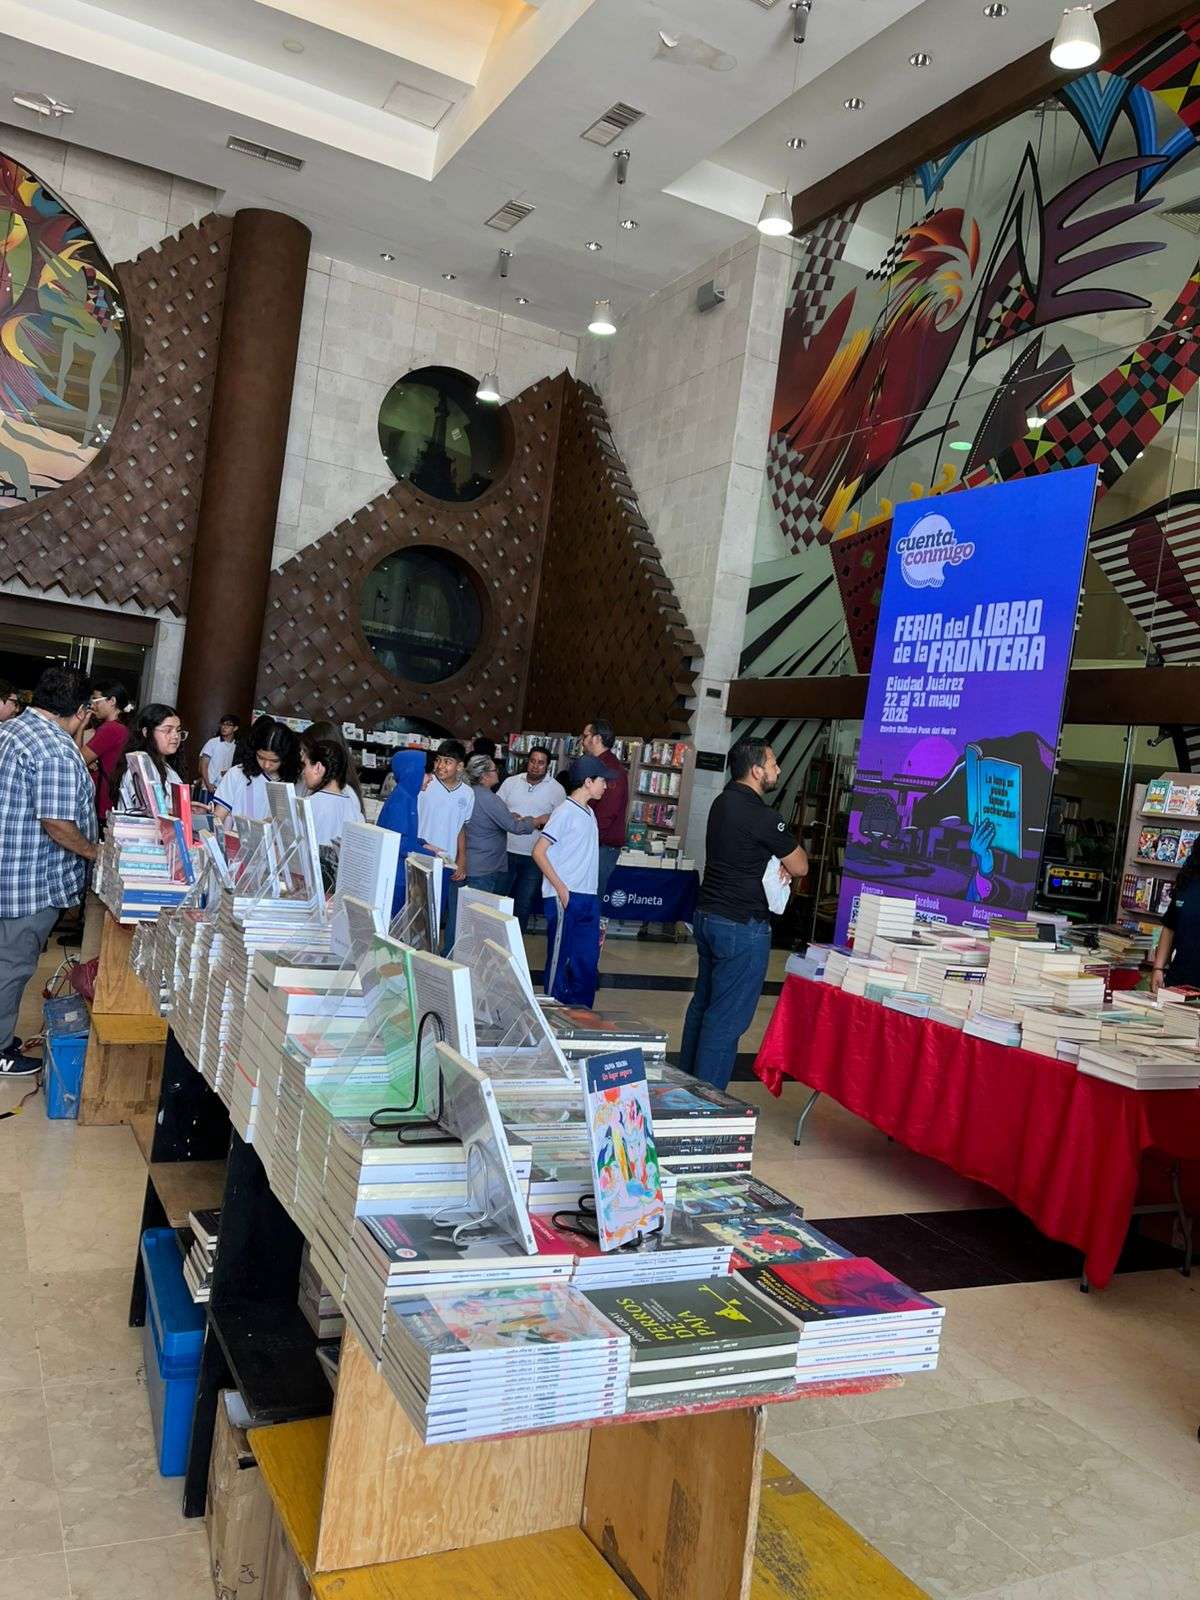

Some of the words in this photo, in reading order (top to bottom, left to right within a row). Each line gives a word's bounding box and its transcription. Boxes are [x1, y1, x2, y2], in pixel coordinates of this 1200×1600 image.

[897, 529, 954, 552] cuenta
[904, 541, 975, 565] conmigo
[893, 613, 943, 642] FERIA
[943, 615, 970, 639] del
[971, 599, 1044, 638] LIBRO
[892, 643, 911, 664] de
[914, 641, 928, 663] la
[926, 635, 1046, 673] FRONTERA
[886, 676, 925, 691] Ciudad
[925, 673, 965, 691] Juárez
[883, 692, 898, 707] 22
[900, 692, 911, 707] al
[912, 692, 926, 707] 31
[928, 694, 960, 710] mayo
[627, 893, 663, 906] Planeta
[914, 894, 940, 911] Facebook
[608, 1312, 630, 1328] GRAY
[616, 1298, 675, 1341] PERROS
[677, 1310, 717, 1337] PAJA
[666, 1322, 696, 1339] DE
